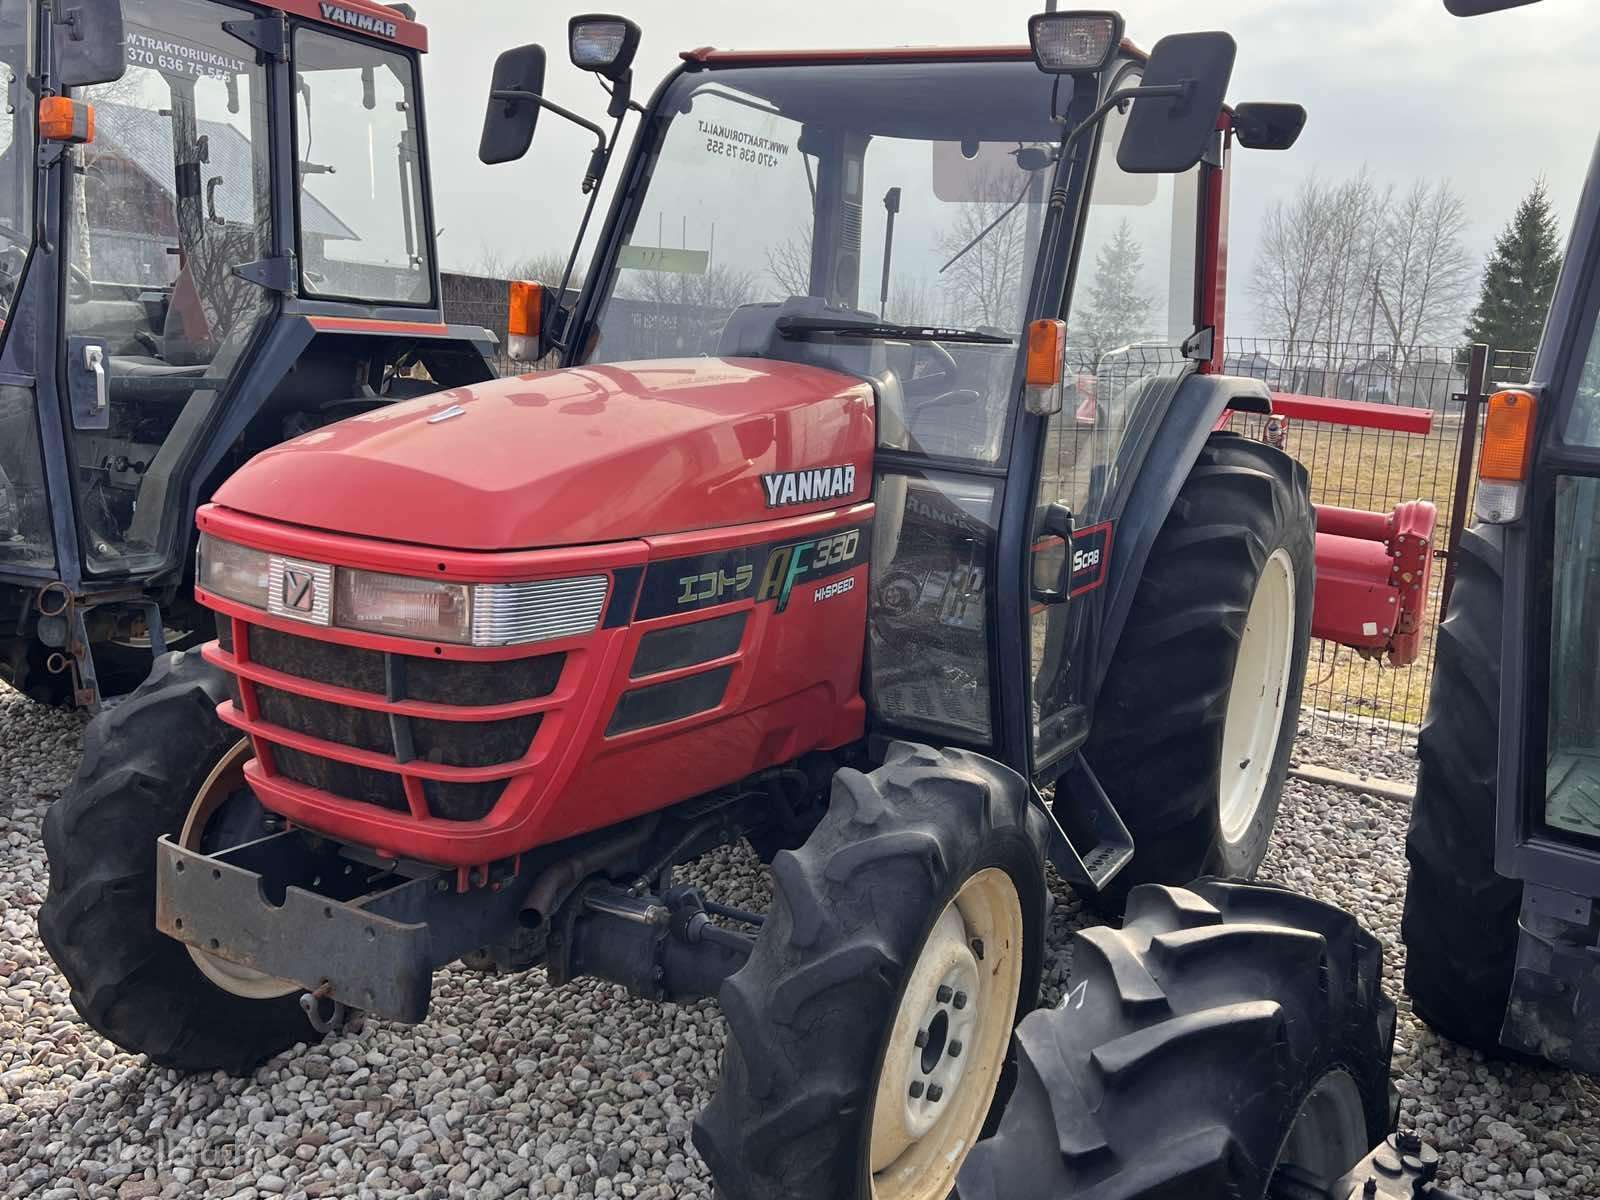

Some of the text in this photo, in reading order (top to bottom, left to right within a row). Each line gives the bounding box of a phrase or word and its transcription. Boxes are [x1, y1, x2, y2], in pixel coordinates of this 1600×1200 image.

[320, 2, 398, 38] YANMAR
[158, 54, 184, 72] 636
[187, 61, 204, 76] 75
[207, 67, 232, 83] 555
[763, 464, 857, 508] YANMAR
[677, 564, 753, 604] エコトラ
[813, 576, 855, 603] HI-SPEED
